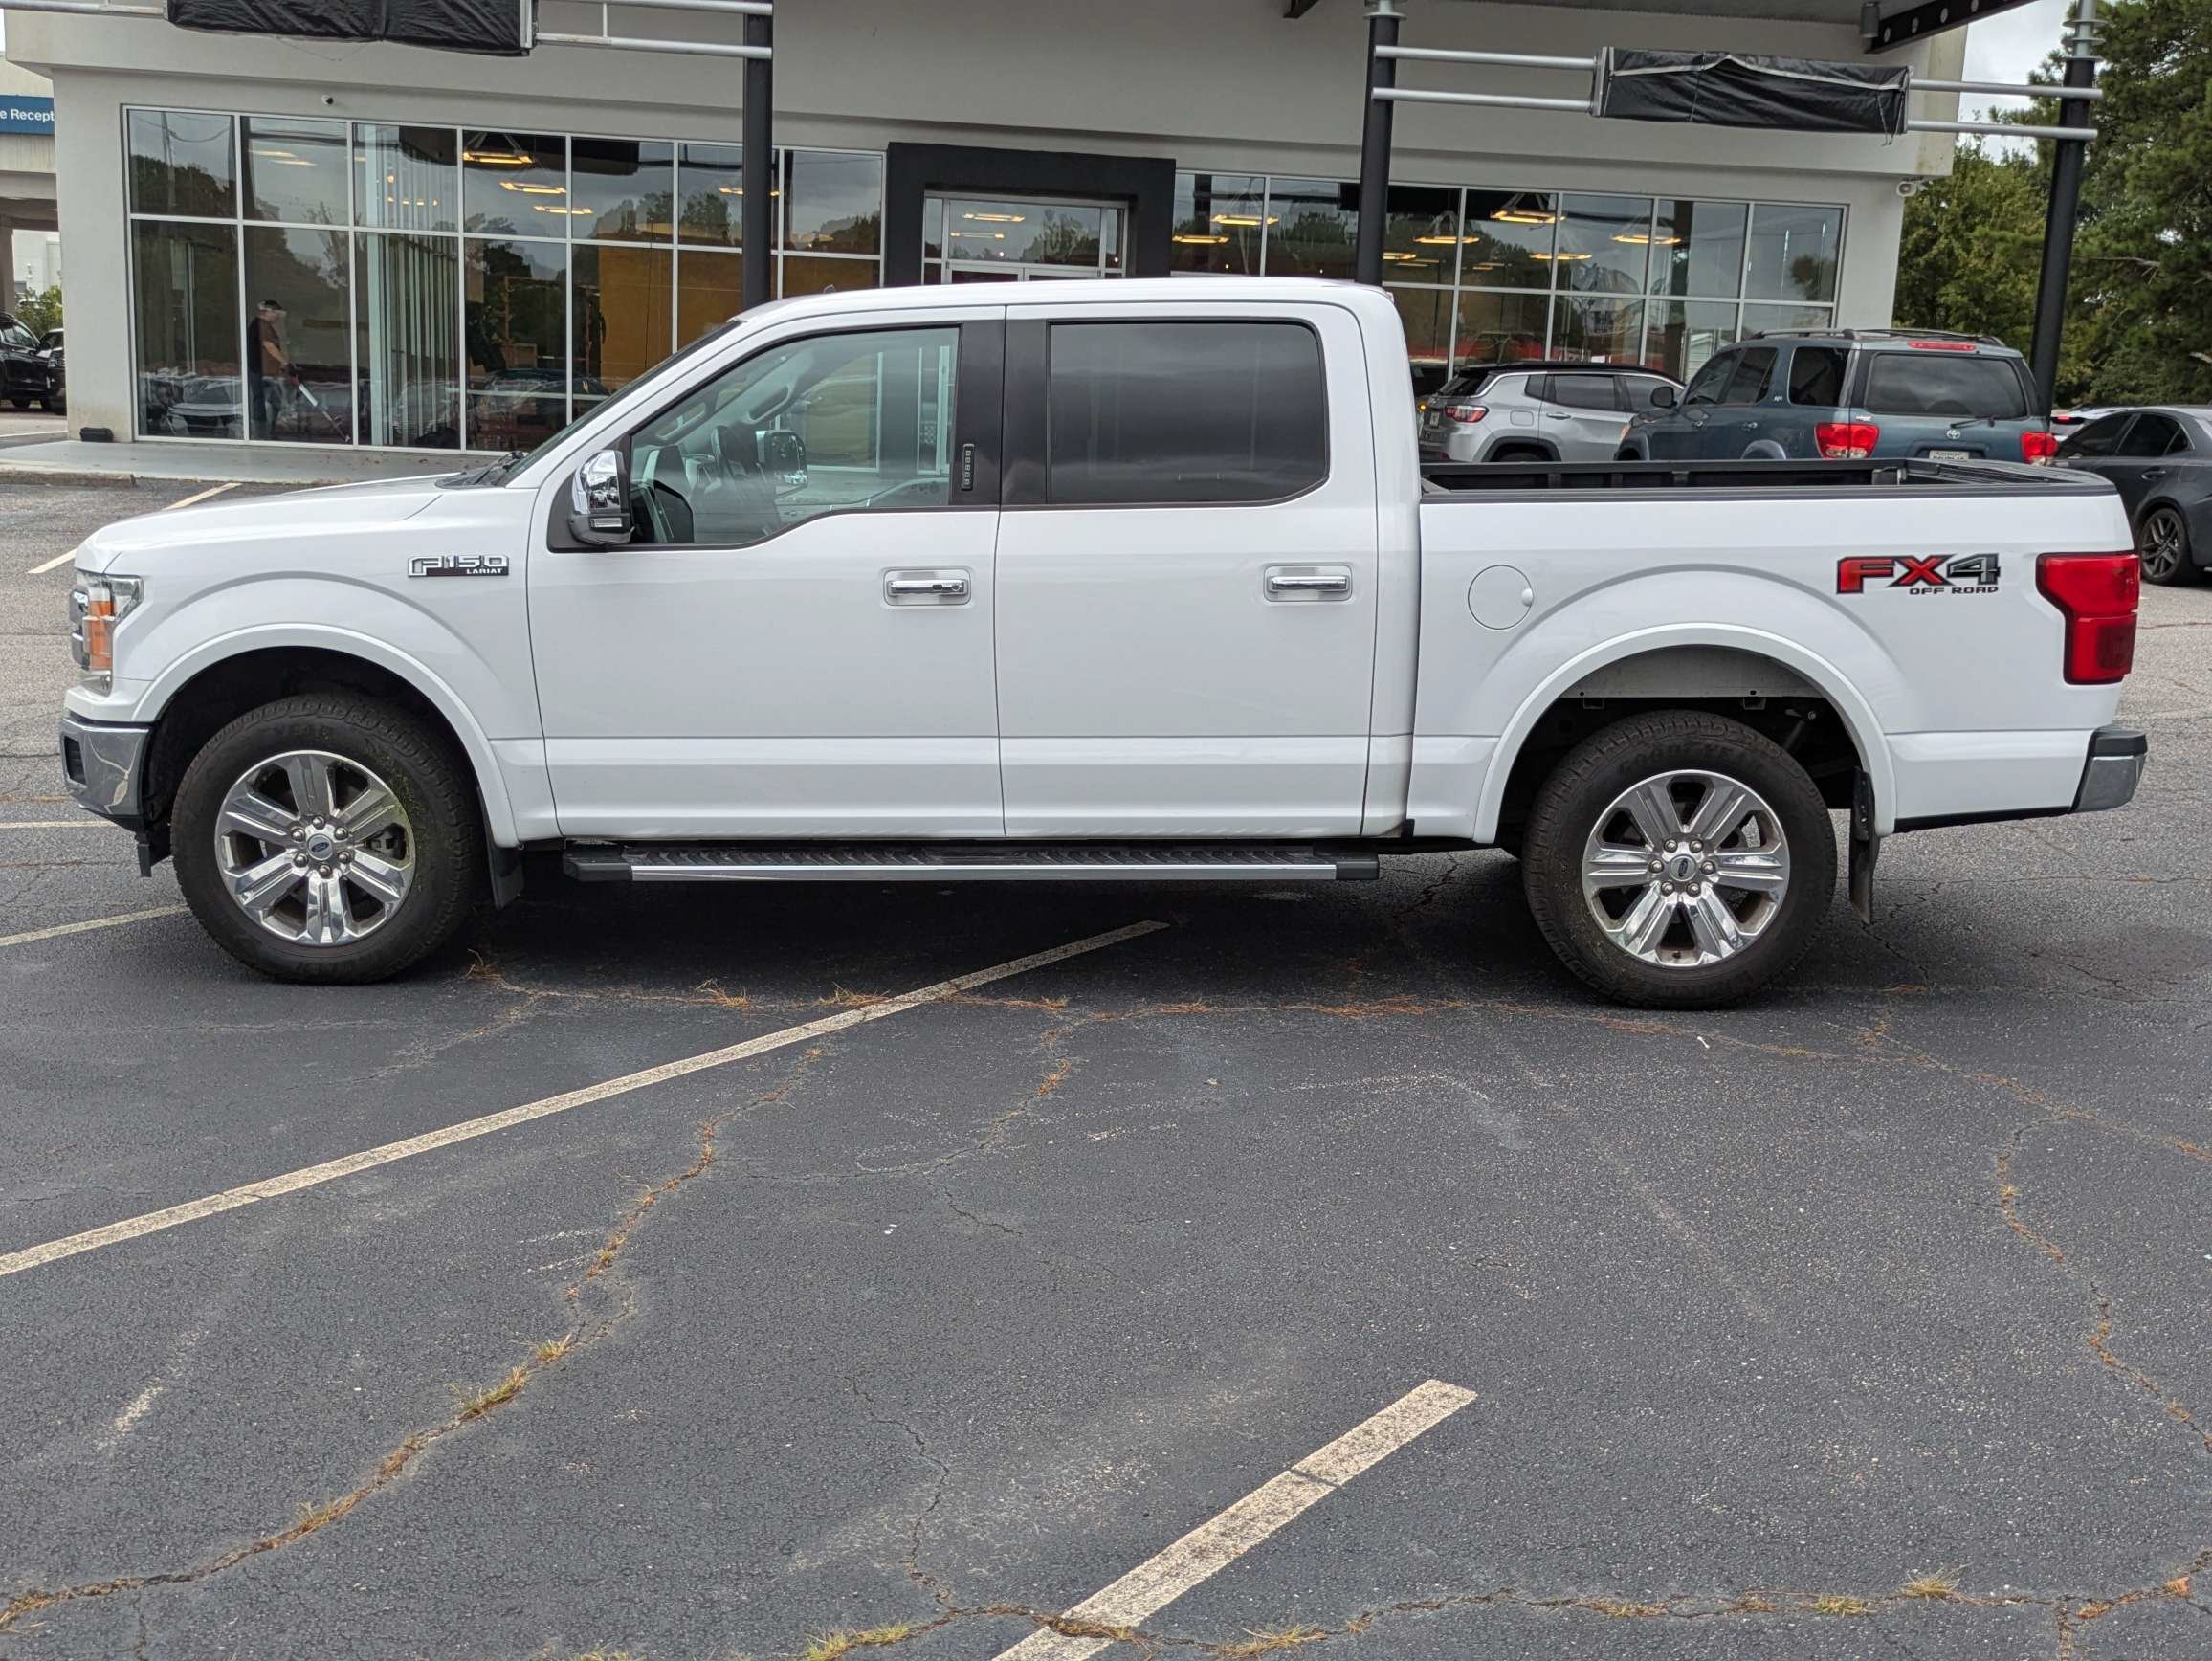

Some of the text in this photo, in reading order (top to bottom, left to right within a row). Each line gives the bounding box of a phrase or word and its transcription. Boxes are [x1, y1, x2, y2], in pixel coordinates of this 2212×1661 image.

[11, 109, 55, 122] Recept
[1836, 553, 2001, 594] FX4
[1951, 587, 1999, 595] ROAD
